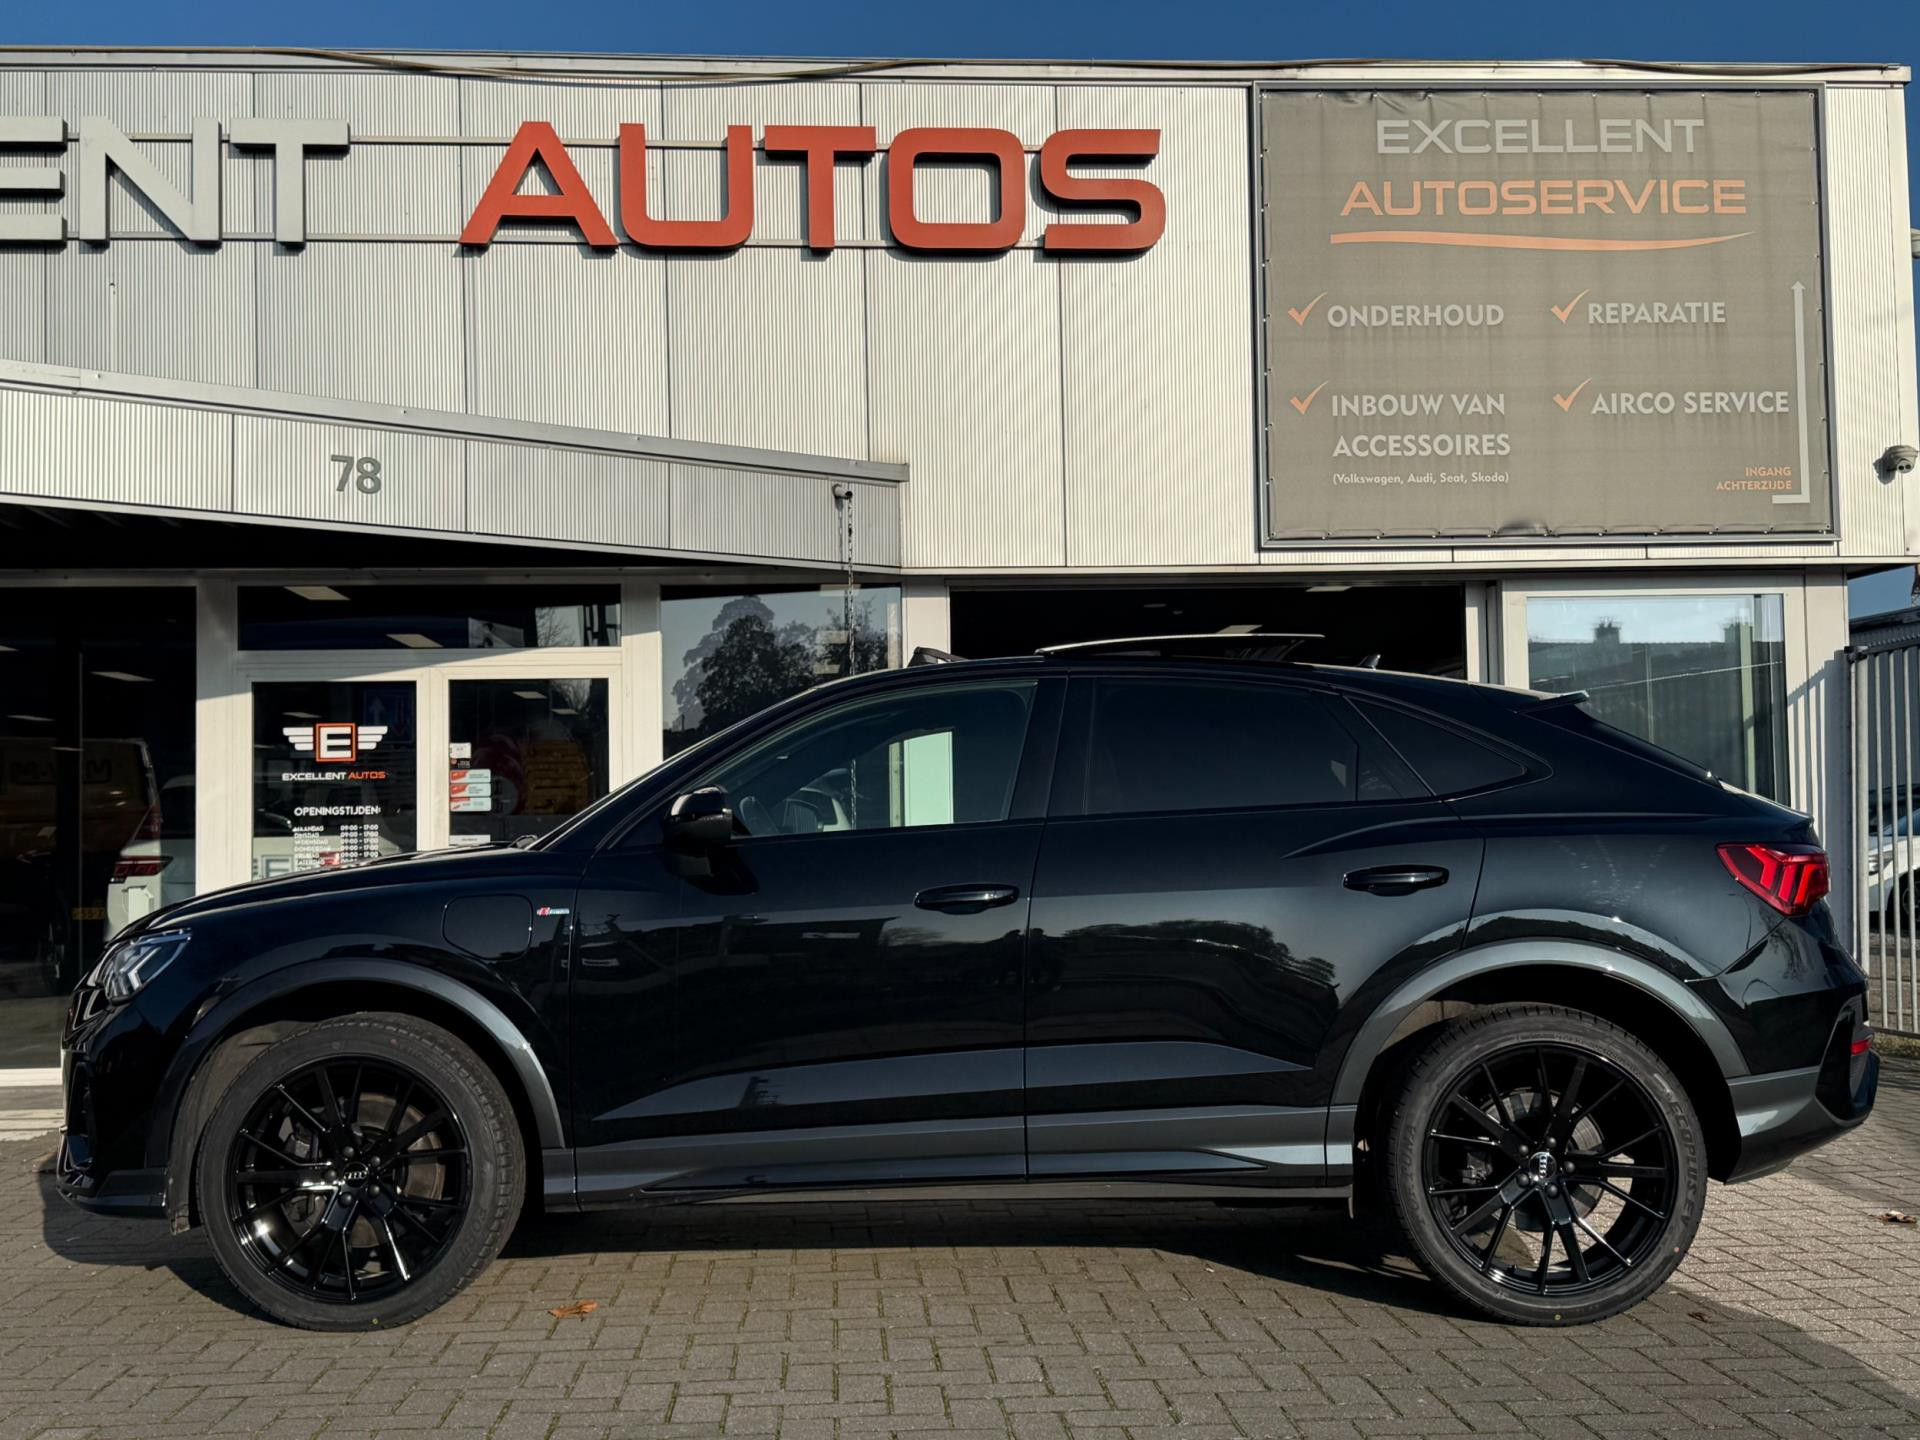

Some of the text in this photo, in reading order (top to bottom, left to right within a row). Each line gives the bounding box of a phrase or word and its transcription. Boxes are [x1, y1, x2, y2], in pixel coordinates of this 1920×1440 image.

[1375, 119, 1705, 154] EXCELLENT
[458, 121, 1166, 251] AUTOS
[1340, 179, 1747, 216] AUTOSERVICE
[1327, 304, 1505, 328] ONDERHOUD
[1588, 301, 1727, 325] REPARATIE
[1331, 393, 1505, 417] INBOUW VAN
[1591, 391, 1790, 414] AIRCO SERVICE
[1332, 434, 1512, 457] ACCESSOIRES
[330, 454, 382, 495] 78
[1332, 472, 1510, 486] (Volkswagen, Audi, Seat, Skoda)
[1745, 466, 1793, 477] INGANG
[1716, 479, 1793, 491] ACHTERZIJDE
[282, 771, 386, 781] EXCELLENT AUTOS
